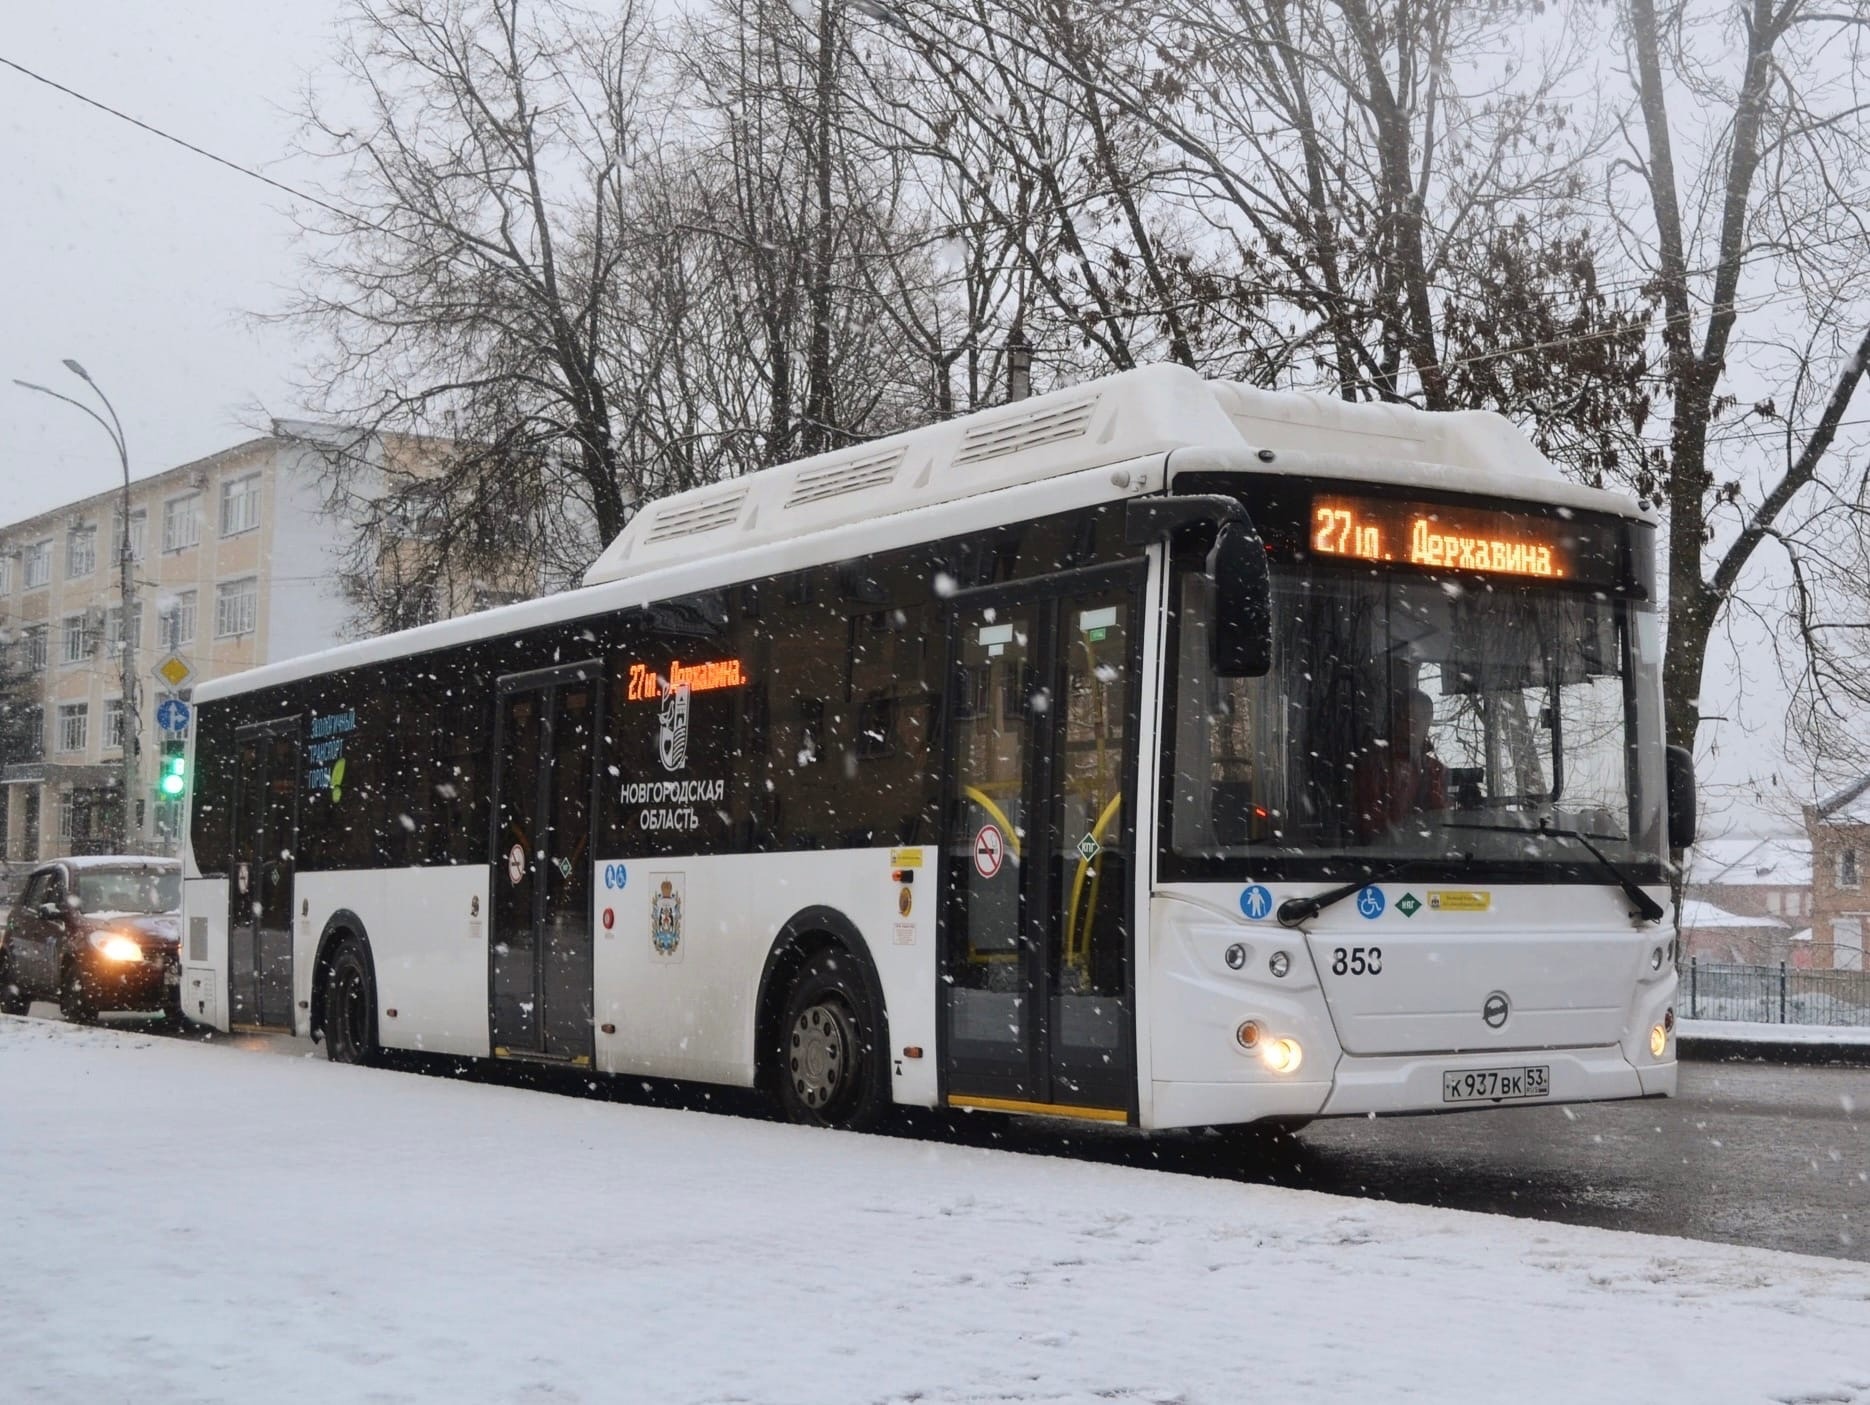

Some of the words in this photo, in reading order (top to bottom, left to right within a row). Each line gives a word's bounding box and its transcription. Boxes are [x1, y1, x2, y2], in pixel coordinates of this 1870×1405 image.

[620, 779, 725, 804] НОВГОРОДСКАЯ
[640, 807, 699, 831] ОБЛАСТЬ
[1527, 1068, 1543, 1086] 53
